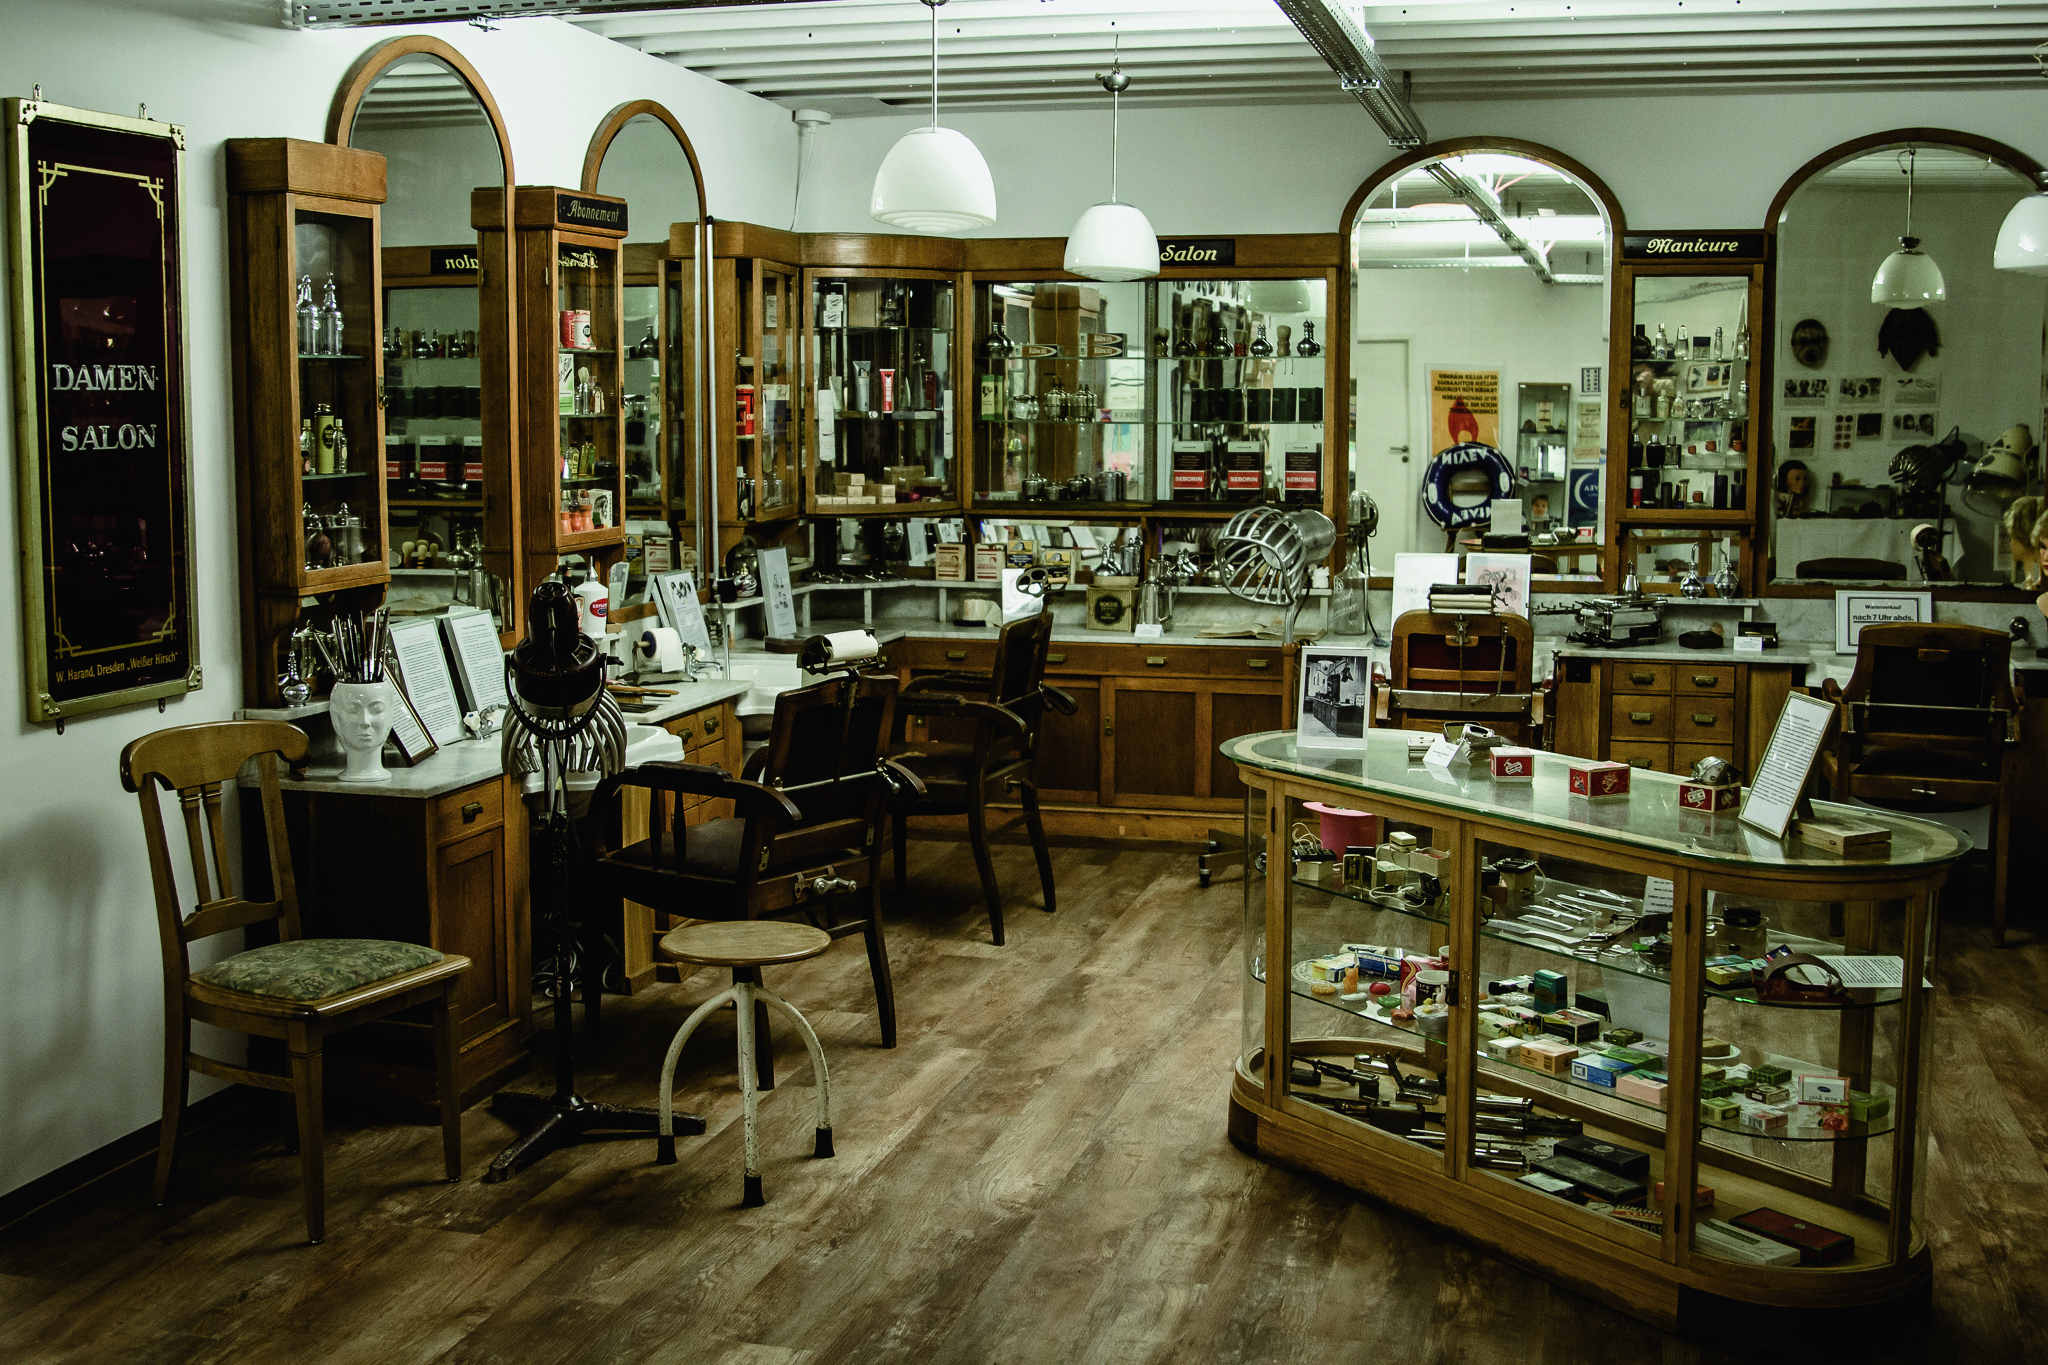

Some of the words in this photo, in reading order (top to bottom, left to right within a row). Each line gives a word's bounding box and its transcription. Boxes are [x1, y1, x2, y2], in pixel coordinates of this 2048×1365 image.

[567, 200, 620, 223] Abonnement
[1160, 244, 1217, 262] Salon
[1646, 238, 1738, 254] Manicure
[62, 424, 157, 452] SALON
[97, 661, 125, 676] Dresden
